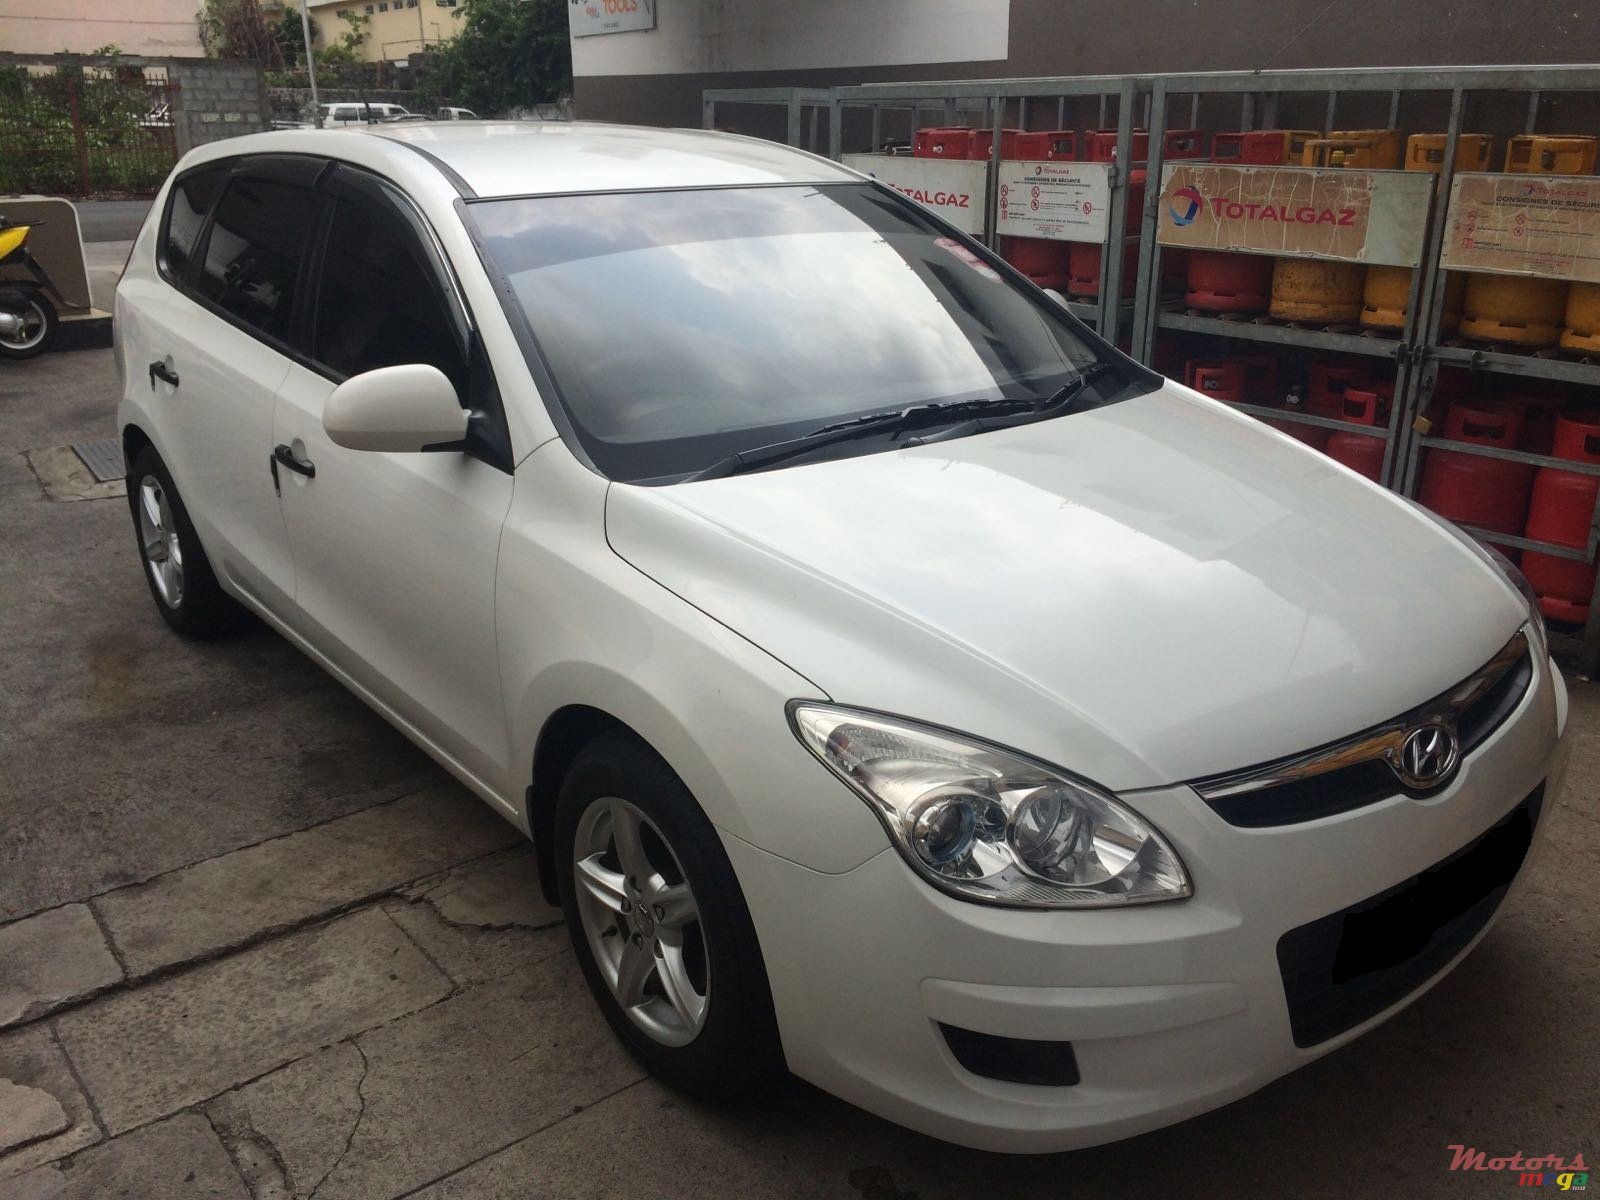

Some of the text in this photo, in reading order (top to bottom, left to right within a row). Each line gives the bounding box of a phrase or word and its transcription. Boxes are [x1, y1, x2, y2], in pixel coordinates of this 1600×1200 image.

[602, 0, 638, 15] TOOLS
[1496, 195, 1549, 206] CONSIGNES
[1551, 198, 1564, 206] DE
[1211, 196, 1357, 226] TOTALGAZ
